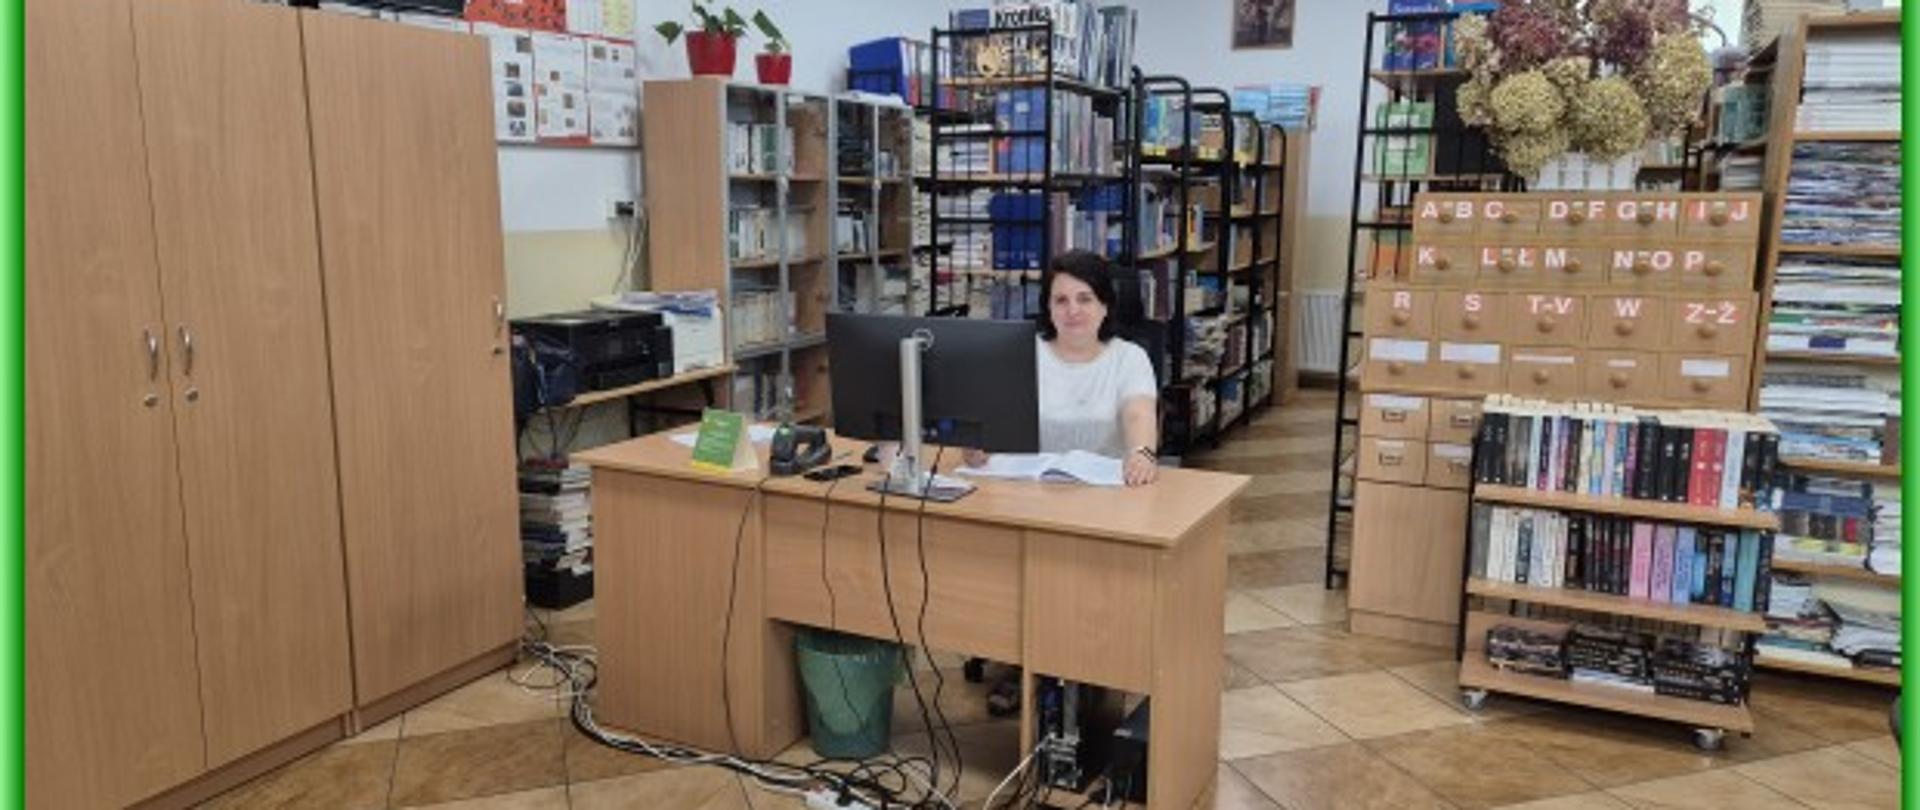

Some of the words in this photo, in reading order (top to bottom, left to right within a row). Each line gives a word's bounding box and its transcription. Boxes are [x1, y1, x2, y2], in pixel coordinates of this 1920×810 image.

[1418, 247, 1435, 265] K
[1545, 247, 1566, 268] M
[1685, 251, 1704, 270] P
[1393, 291, 1411, 309] R
[1464, 294, 1482, 312] S
[1527, 295, 1573, 314] T-V
[1616, 298, 1642, 318] W
